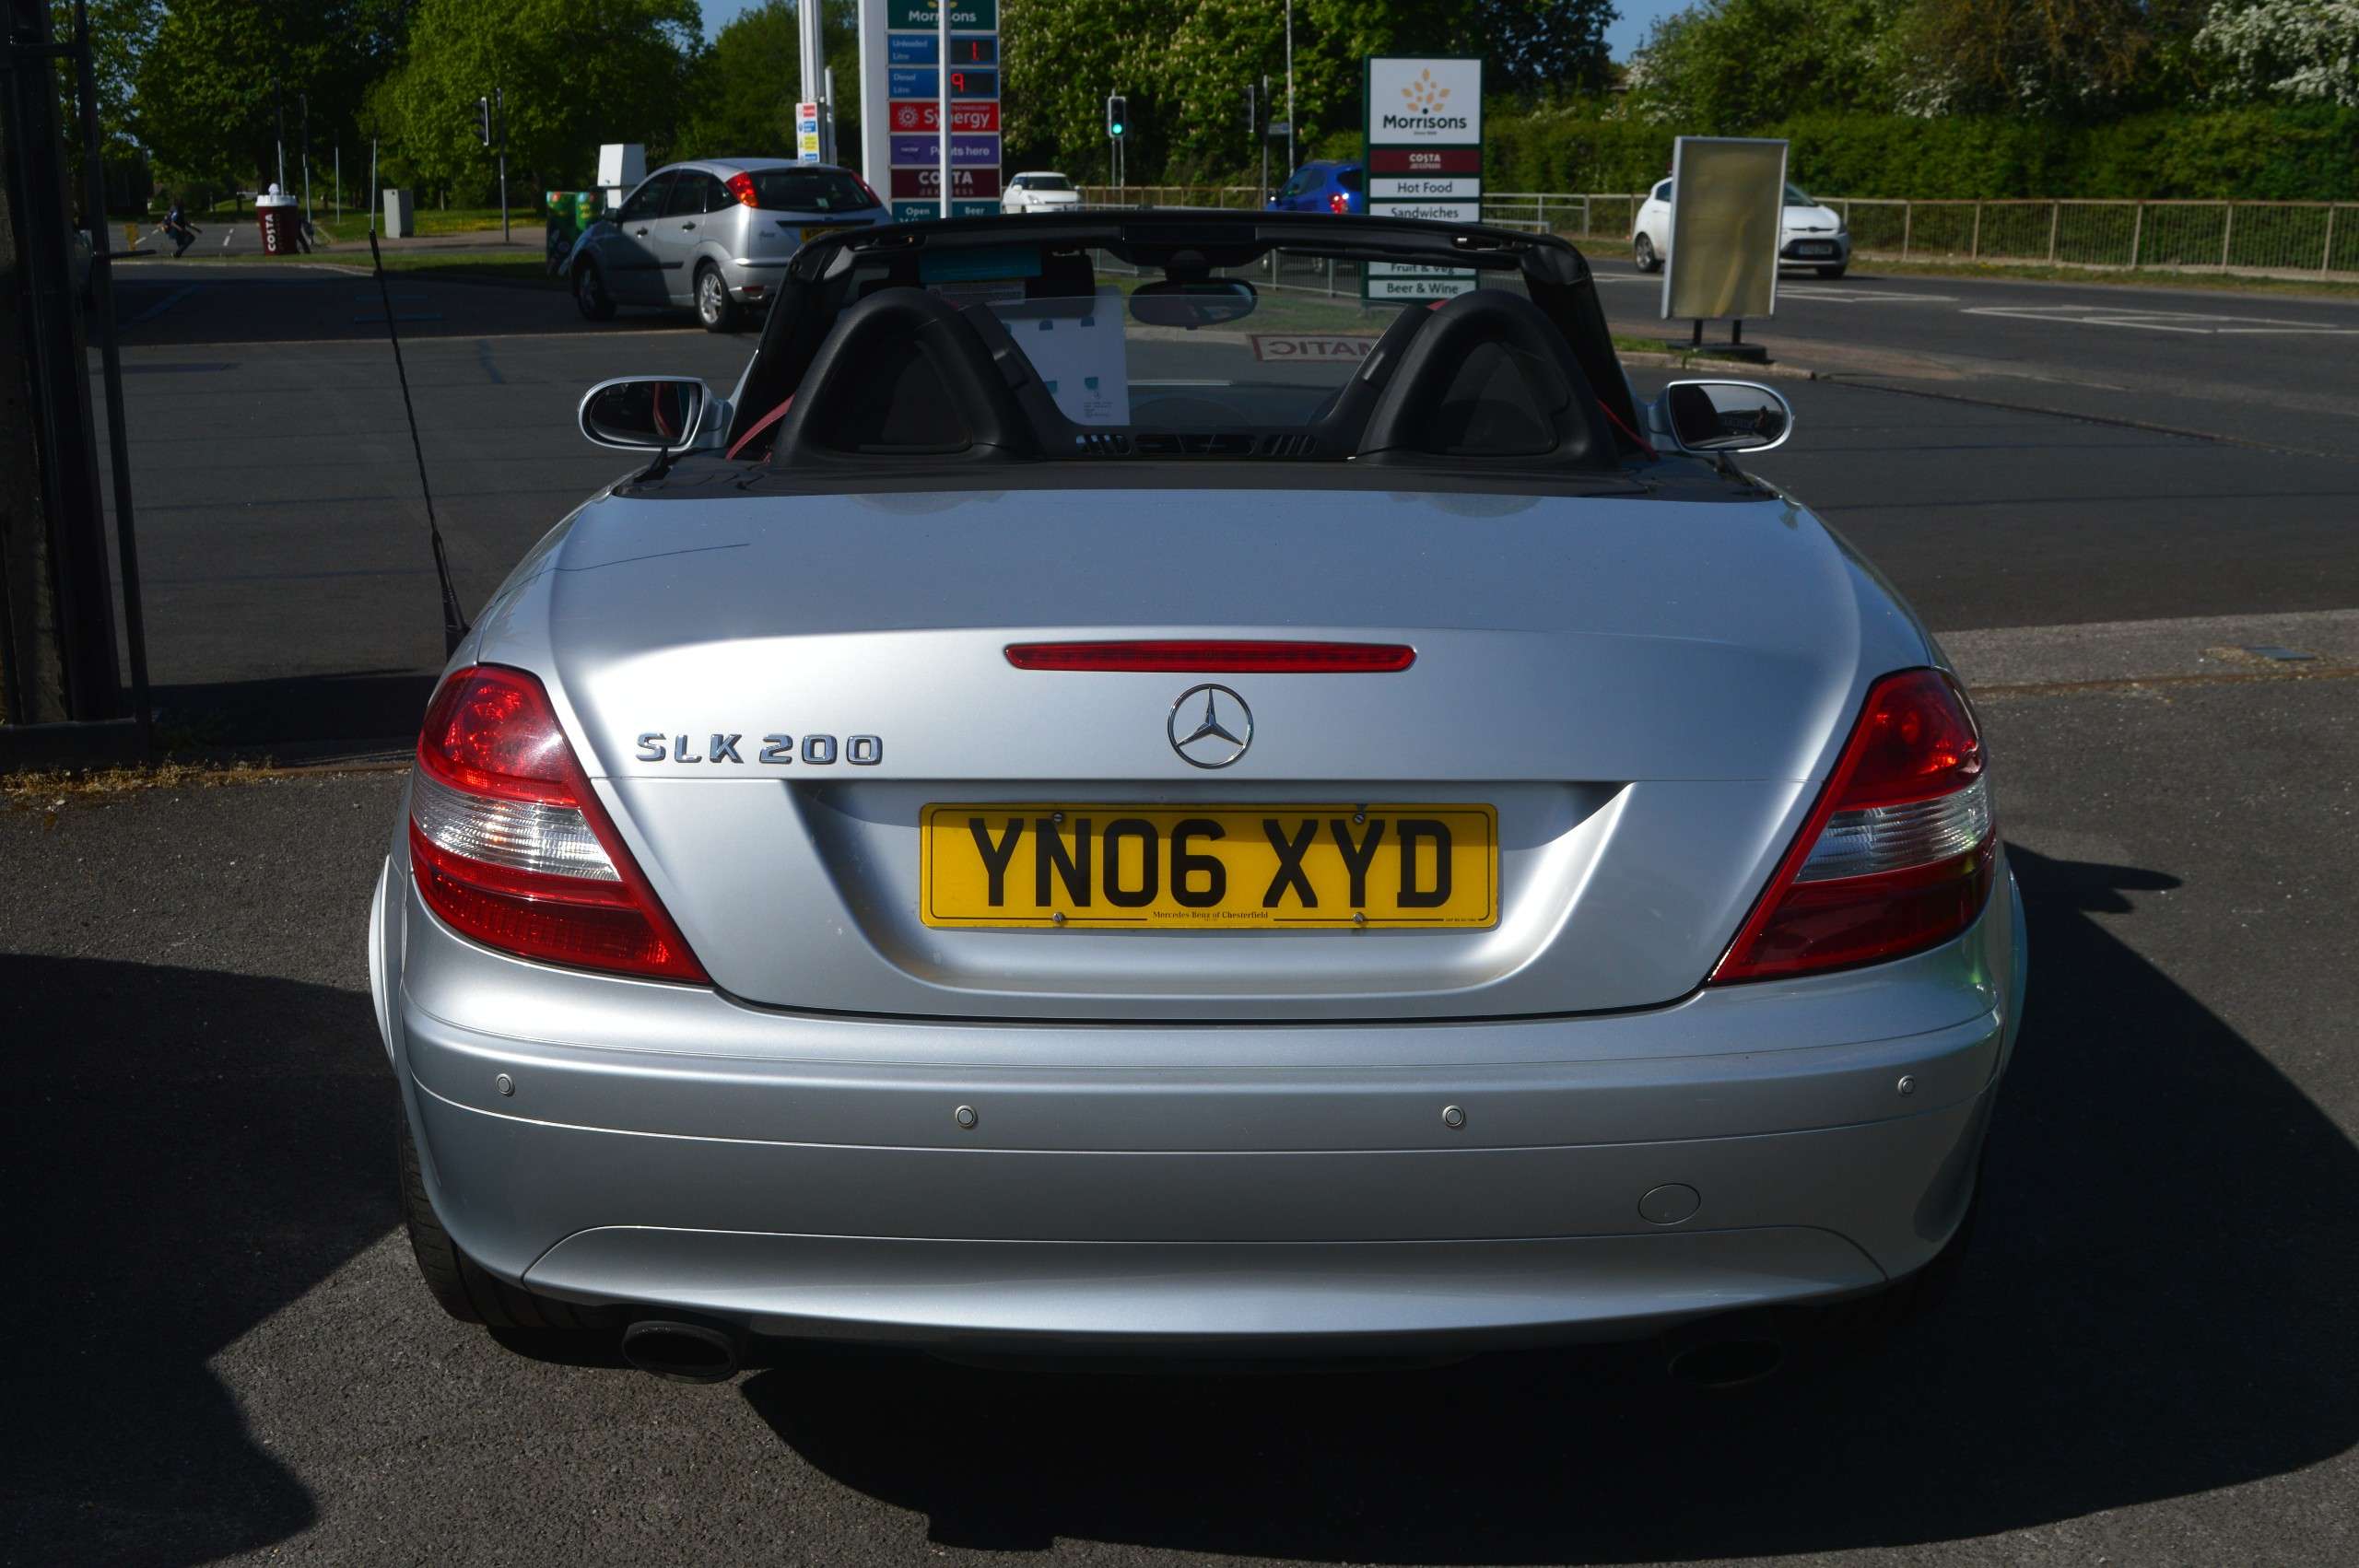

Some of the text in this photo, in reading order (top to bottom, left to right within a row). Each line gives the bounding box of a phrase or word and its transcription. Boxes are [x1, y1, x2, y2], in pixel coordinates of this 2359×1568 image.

[909, 10, 977, 22] Morrons
[1382, 111, 1467, 129] Morrisons
[1409, 154, 1441, 162] COSTA
[919, 171, 973, 184] COTA
[1397, 181, 1452, 193] Hot Food
[905, 206, 930, 216] Open
[1391, 207, 1459, 219] Sandwiches
[264, 213, 276, 252] COSTA
[1387, 283, 1459, 294] Beer & Wine
[636, 732, 884, 766] SLK 200
[968, 817, 1452, 908] YN06 XYD
